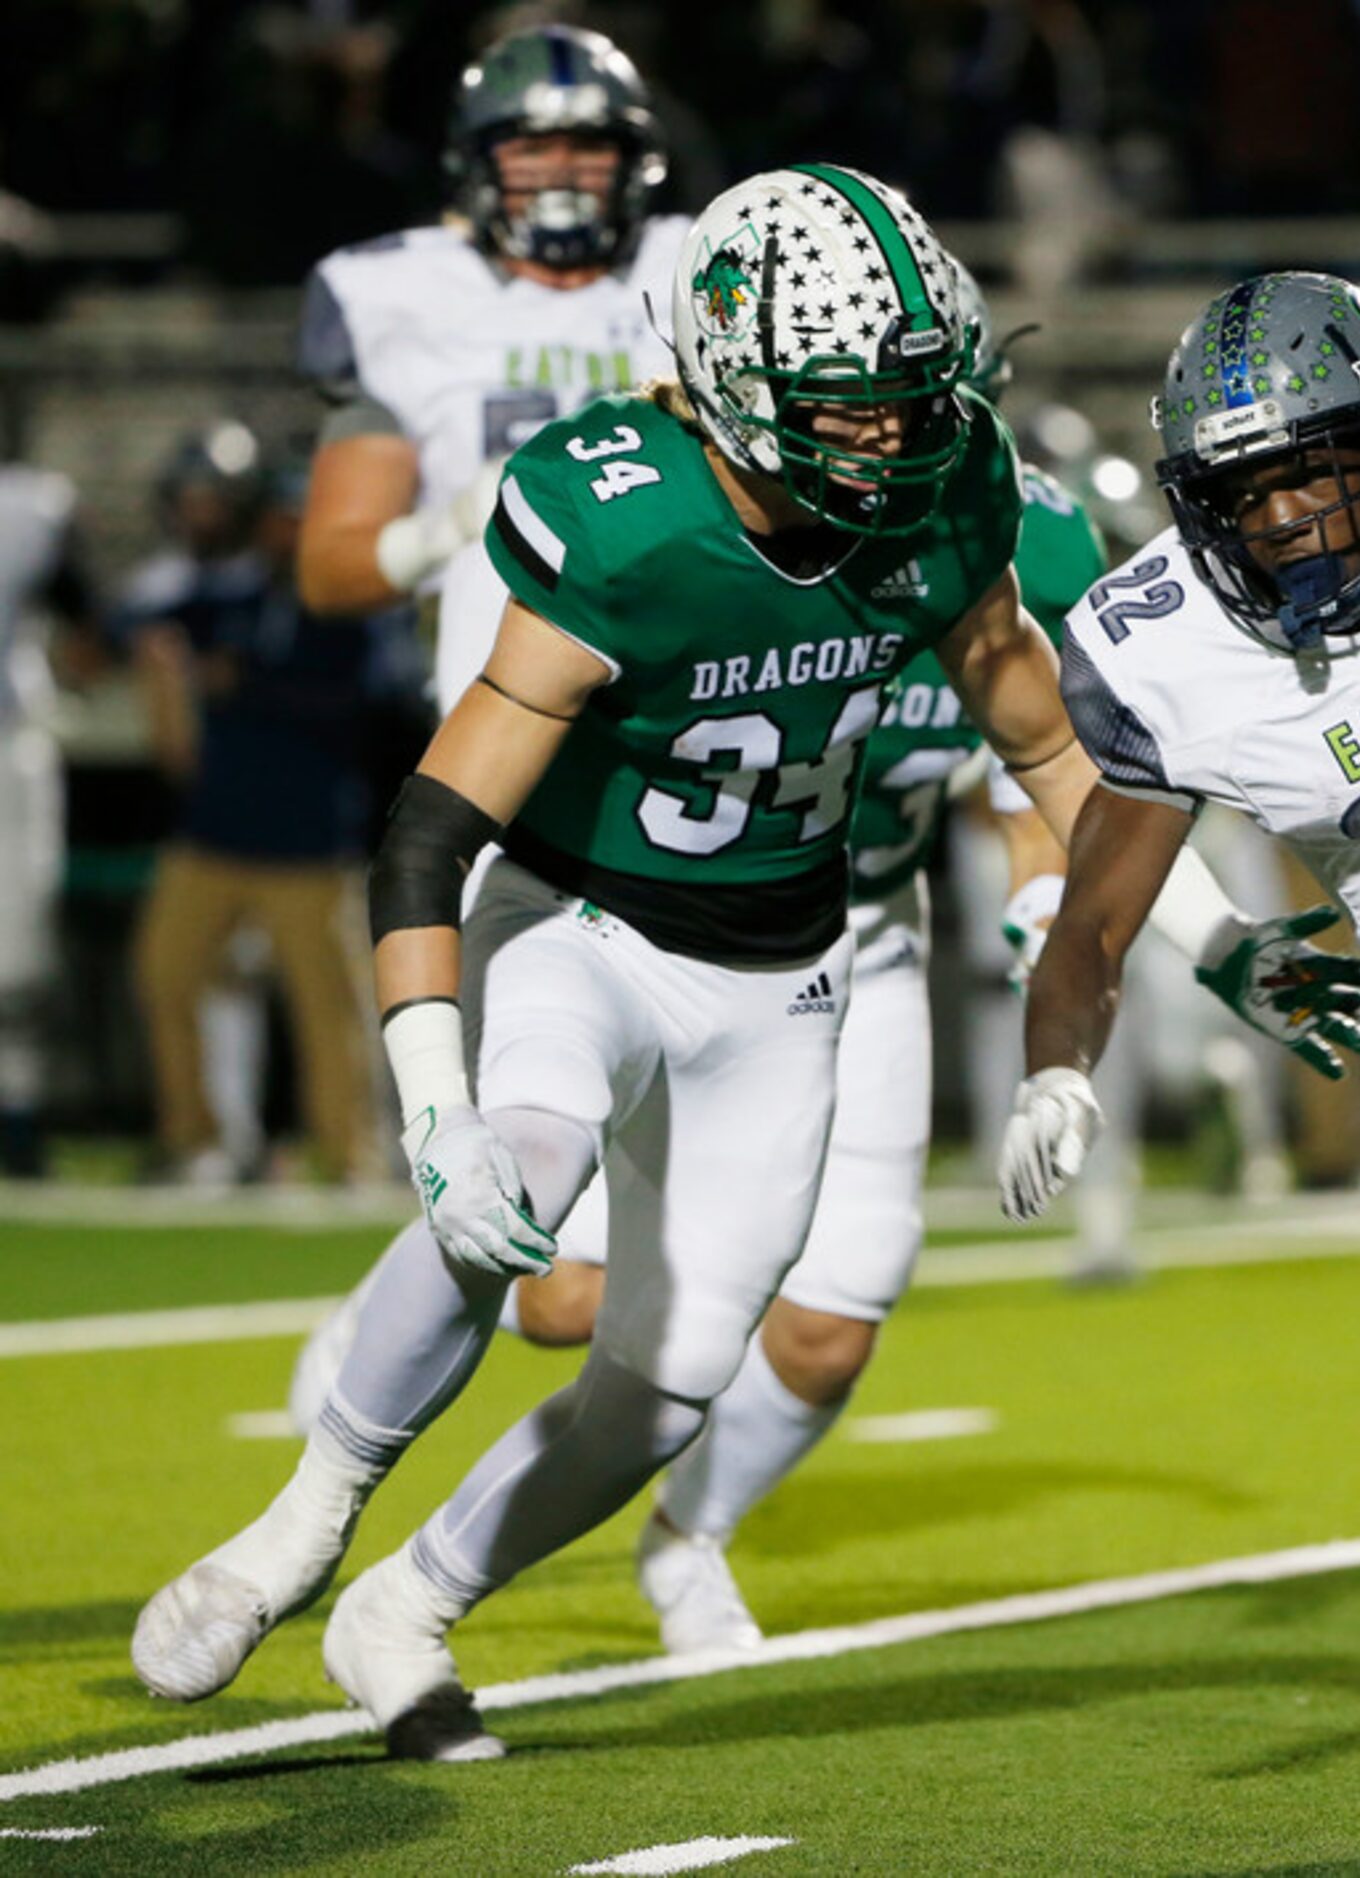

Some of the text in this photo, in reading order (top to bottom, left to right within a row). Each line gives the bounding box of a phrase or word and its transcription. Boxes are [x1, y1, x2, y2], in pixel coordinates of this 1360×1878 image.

[564, 424, 662, 503] 34
[1088, 555, 1185, 646] 22
[689, 634, 902, 700] DRAGONS
[636, 681, 882, 857] 34
